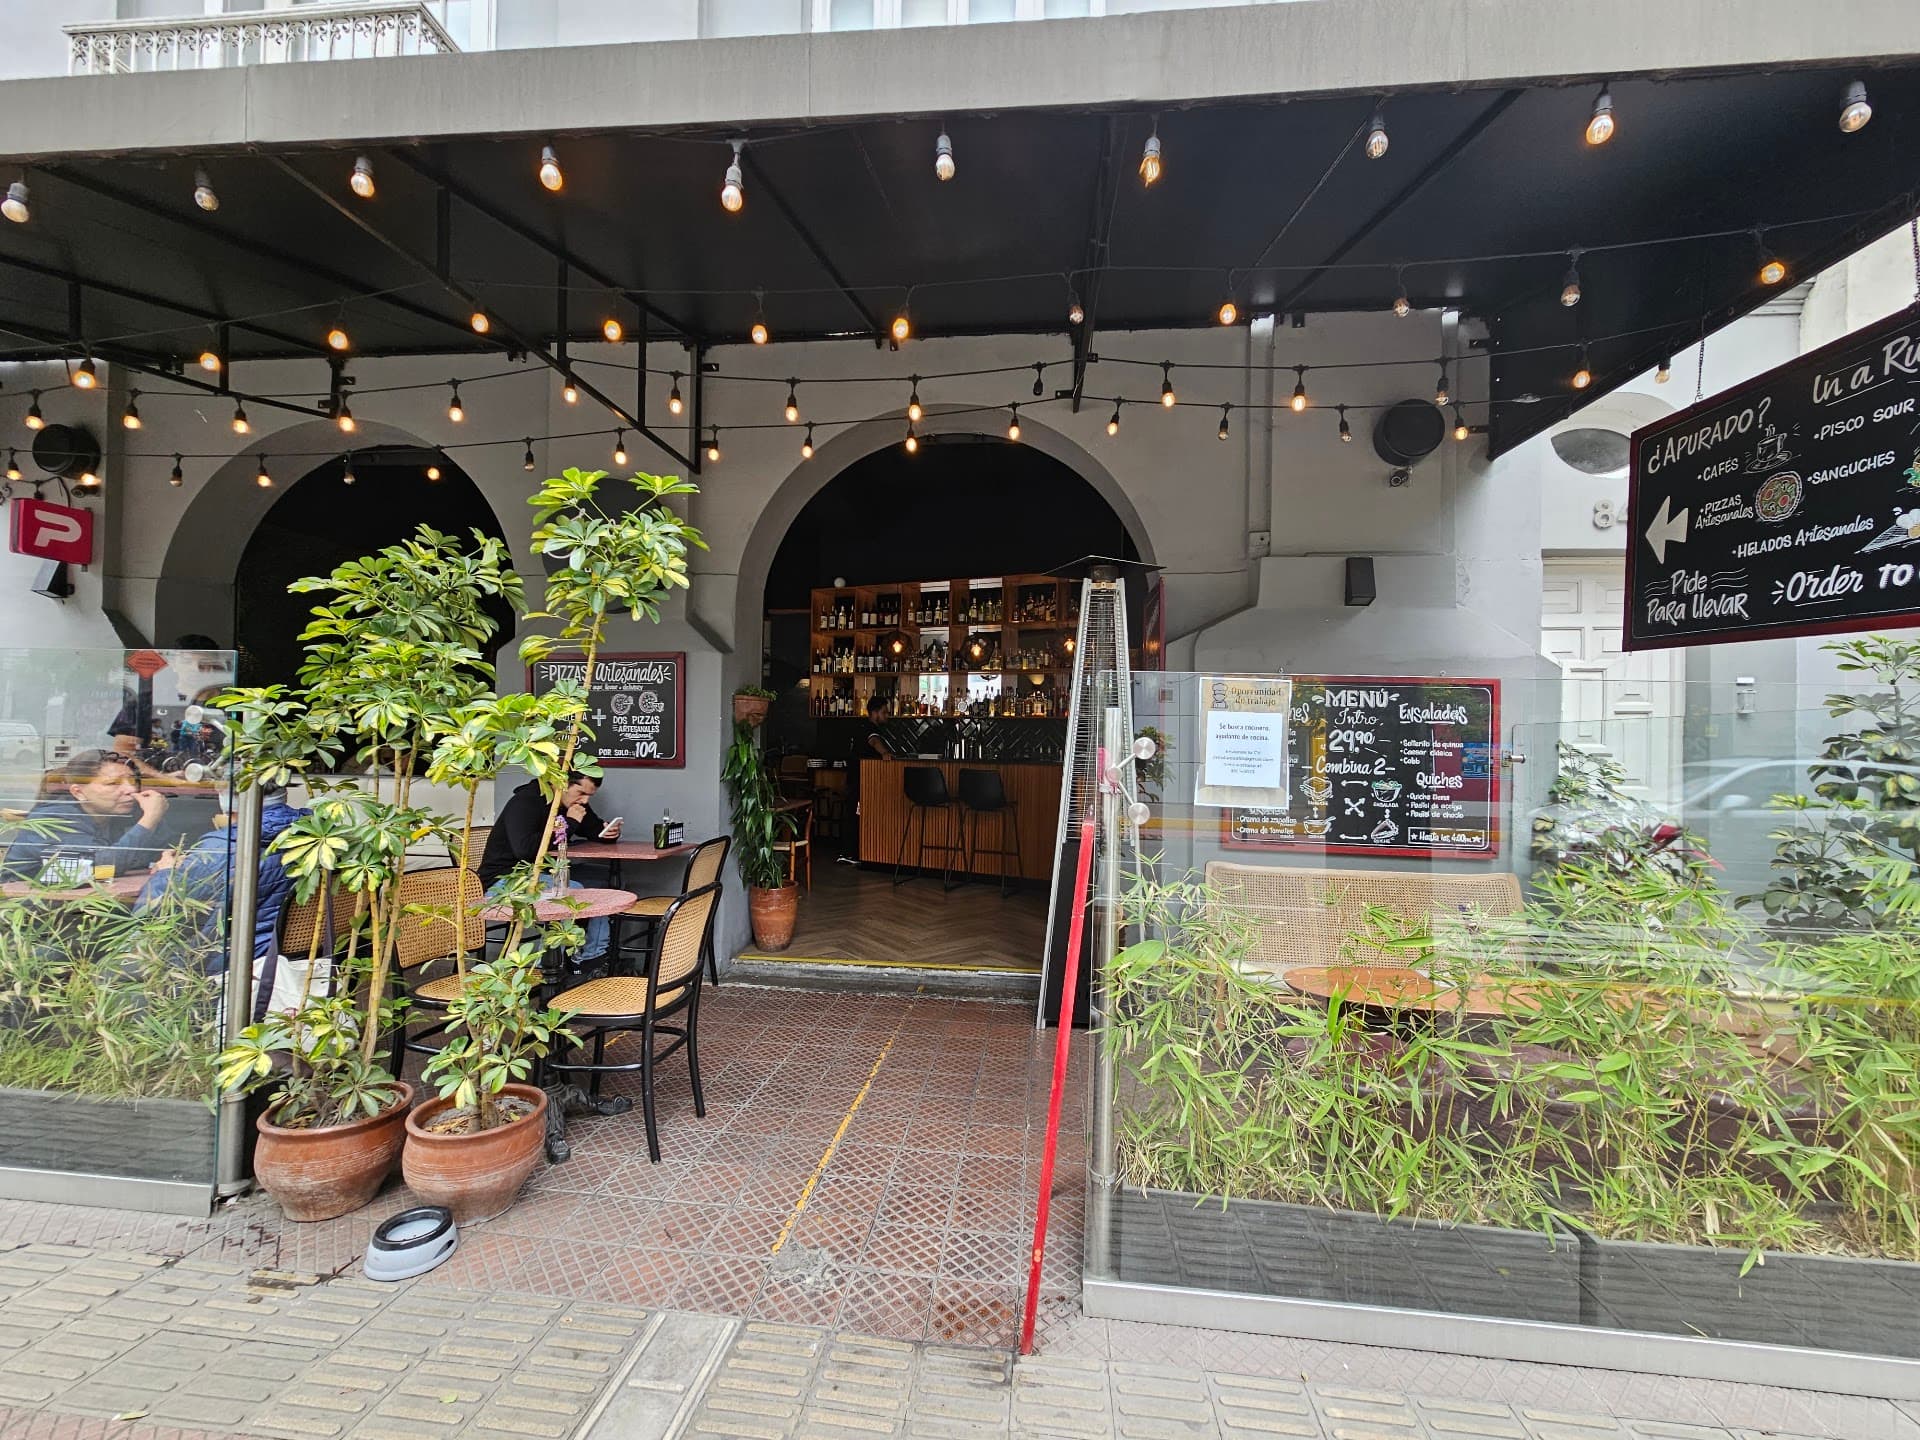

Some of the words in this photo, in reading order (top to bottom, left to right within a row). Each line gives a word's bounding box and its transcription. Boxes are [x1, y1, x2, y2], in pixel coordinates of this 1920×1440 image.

[1813, 374, 1843, 404] In
[1850, 365, 1875, 390] a
[1820, 415, 1865, 441] PISCO
[1872, 398, 1915, 423] SOUR
[1647, 396, 1772, 475] ¿APURADO?
[1811, 450, 1896, 485] SANGUCHES
[1704, 494, 1743, 515] PIZZAS
[1695, 503, 1754, 530] Artesanales
[1737, 535, 1793, 559] HELADOS
[1794, 514, 1875, 548] Artesanales
[1671, 569, 1708, 595] Pide
[1786, 564, 1864, 602] Order
[1878, 563, 1915, 590] TO
[549, 664, 587, 682] PIZZAS
[1324, 688, 1389, 709] MENÚ
[612, 715, 628, 725] DOS
[631, 715, 661, 725] PIZZAS
[618, 725, 660, 733] ARTESANALES
[598, 748, 611, 756] POR
[1315, 755, 1372, 775] Combina
[1373, 757, 1386, 775] 2
[1416, 771, 1464, 789] Quiches
